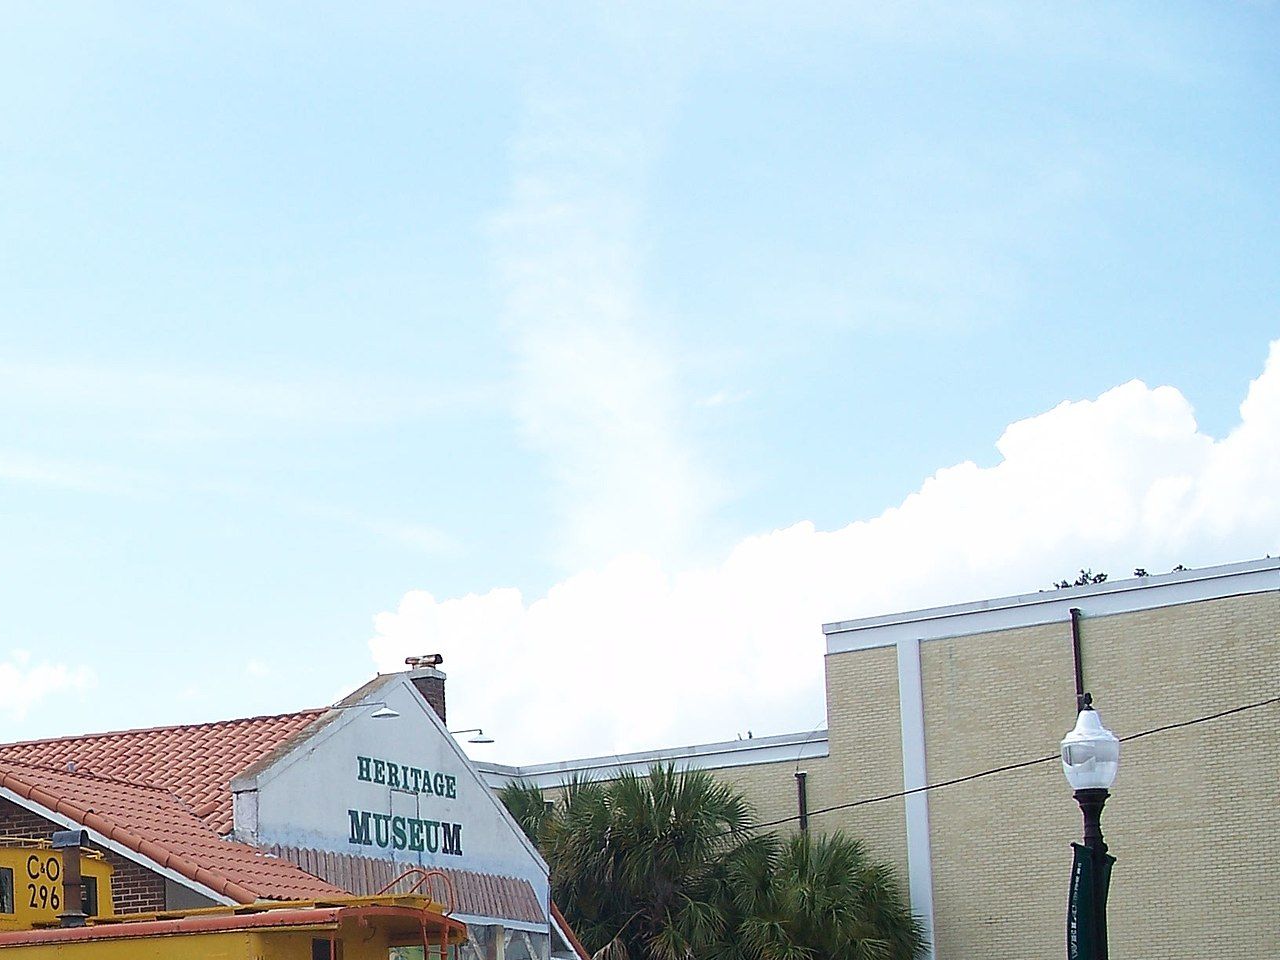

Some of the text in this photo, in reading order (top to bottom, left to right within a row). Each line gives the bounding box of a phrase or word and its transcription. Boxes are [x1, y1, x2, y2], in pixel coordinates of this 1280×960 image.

[357, 756, 456, 799] HERITAGE
[348, 809, 463, 856] MUSEUM
[27, 855, 60, 881] C&O
[28, 884, 60, 910] 296
